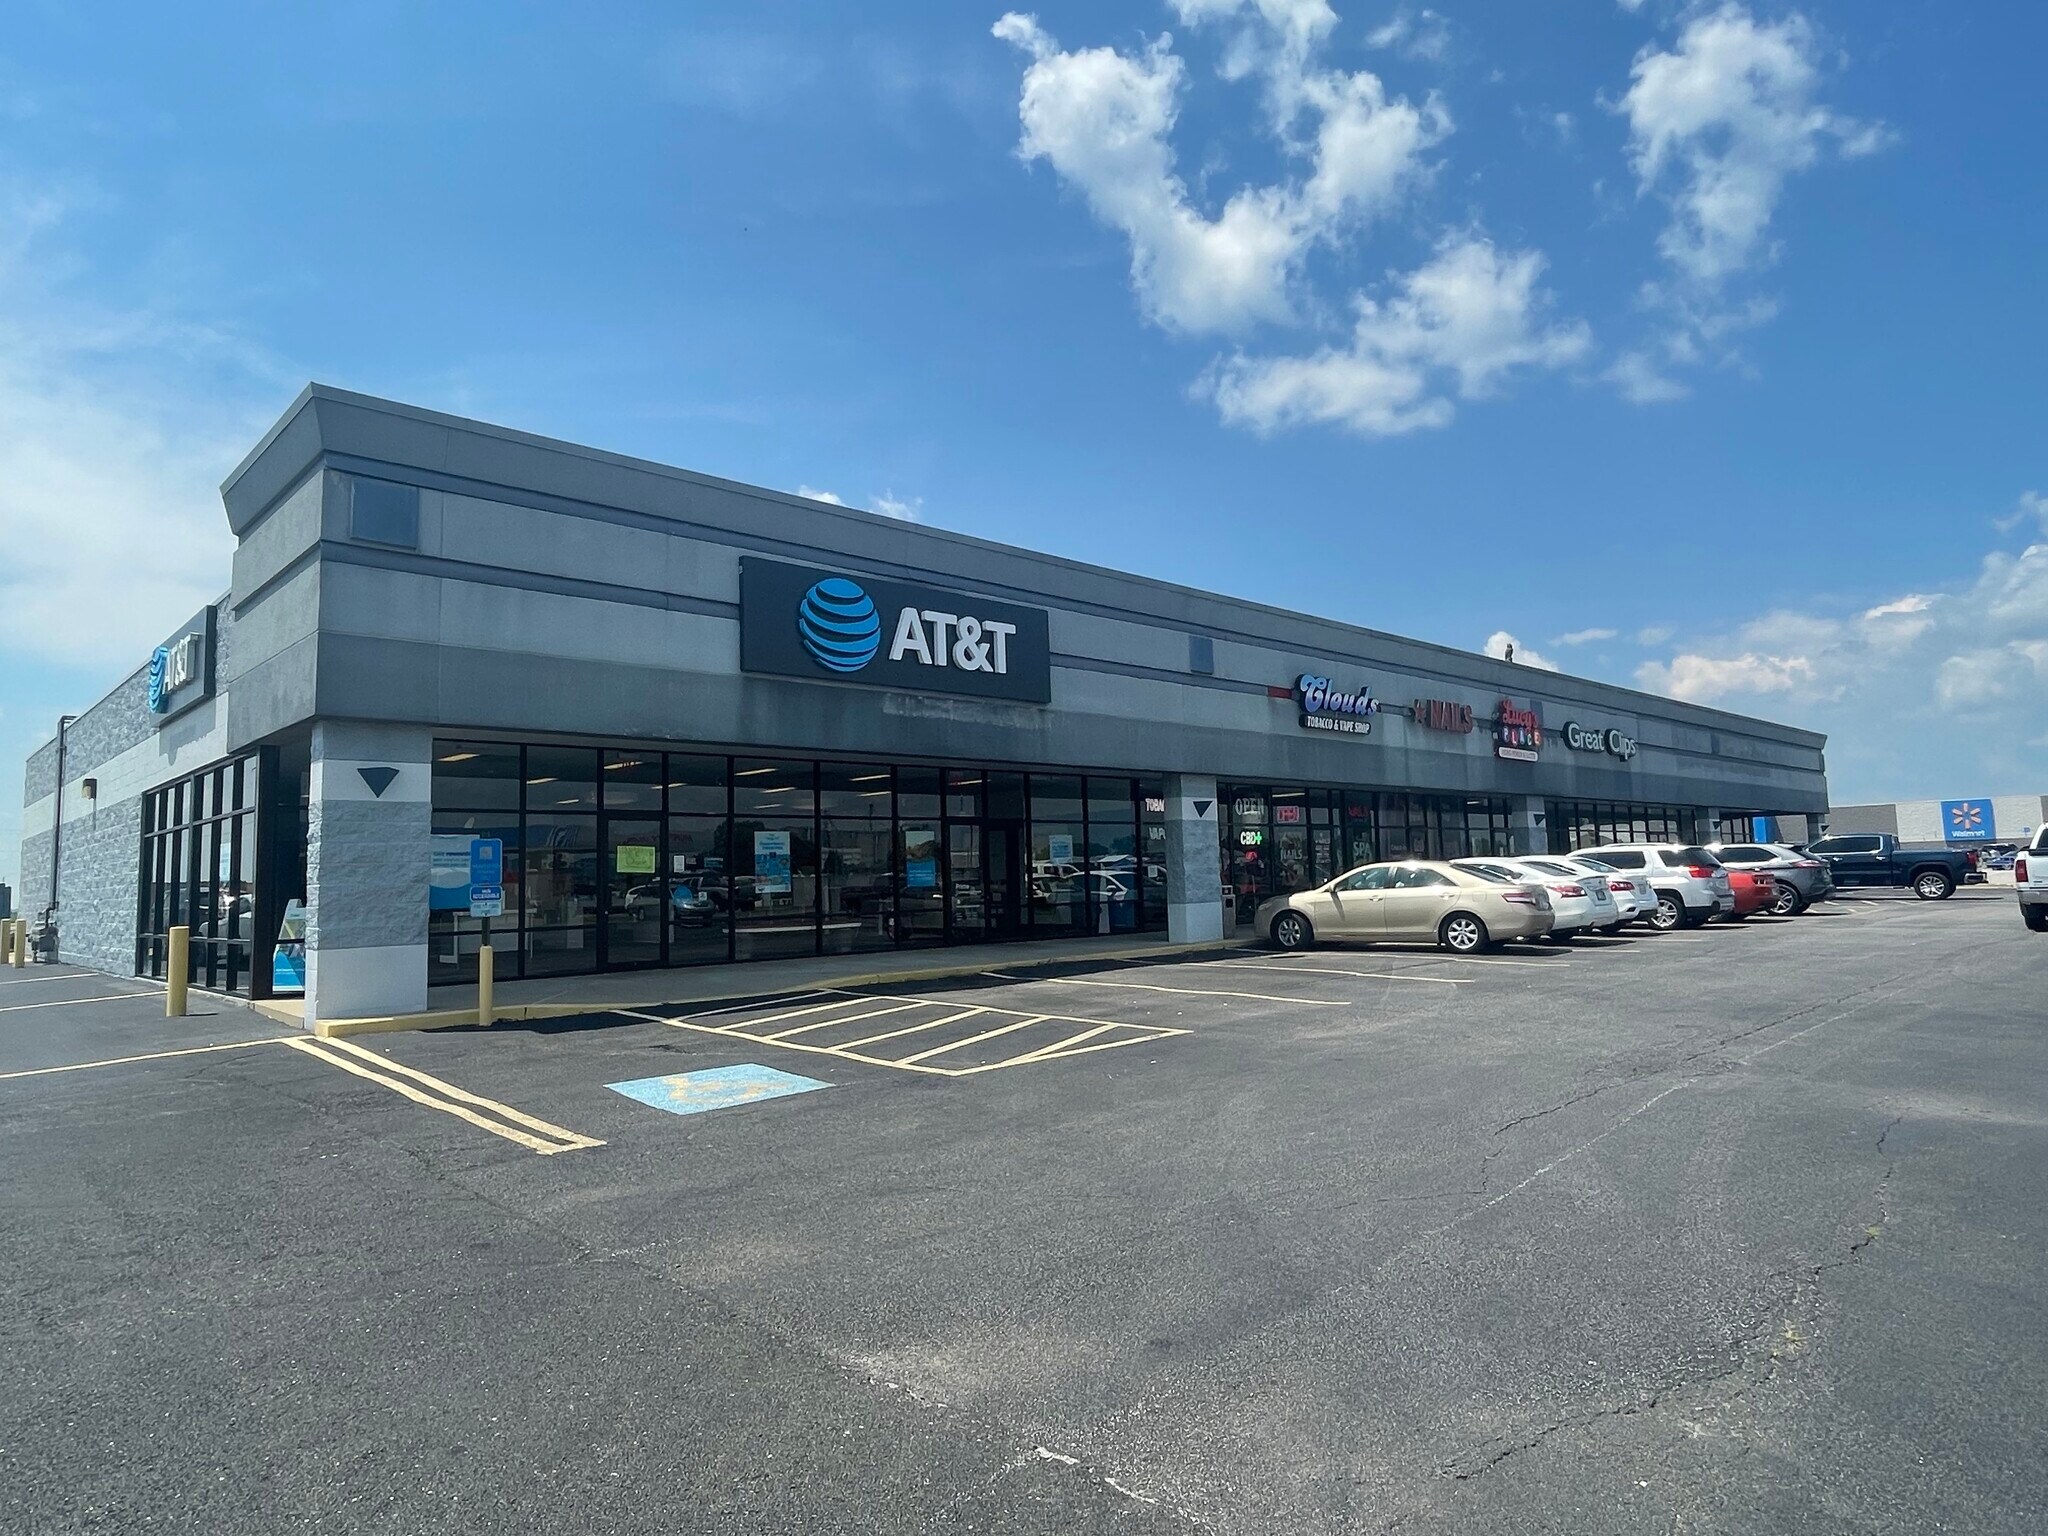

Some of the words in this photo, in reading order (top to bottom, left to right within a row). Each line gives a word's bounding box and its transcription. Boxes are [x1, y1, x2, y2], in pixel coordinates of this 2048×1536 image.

[889, 606, 1016, 674] AT&T
[162, 632, 200, 695] AT&T
[1299, 674, 1379, 717] Clouds
[1307, 715, 1333, 730] TOBACCO
[1333, 719, 1339, 731] &
[1339, 720, 1354, 732] VAPE
[1354, 722, 1370, 734] SHOP
[1430, 698, 1473, 734] NAILS
[1501, 699, 1539, 732] Lucy's
[1503, 726, 1543, 748] PLACE
[1568, 723, 1605, 751] Great
[1609, 730, 1636, 760] Clips
[1145, 798, 1165, 812] TOBA
[1235, 797, 1264, 816] OPEN
[1951, 829, 1986, 838] Walmart
[1280, 848, 1302, 860] NAILS
[1353, 841, 1371, 857] SPA
